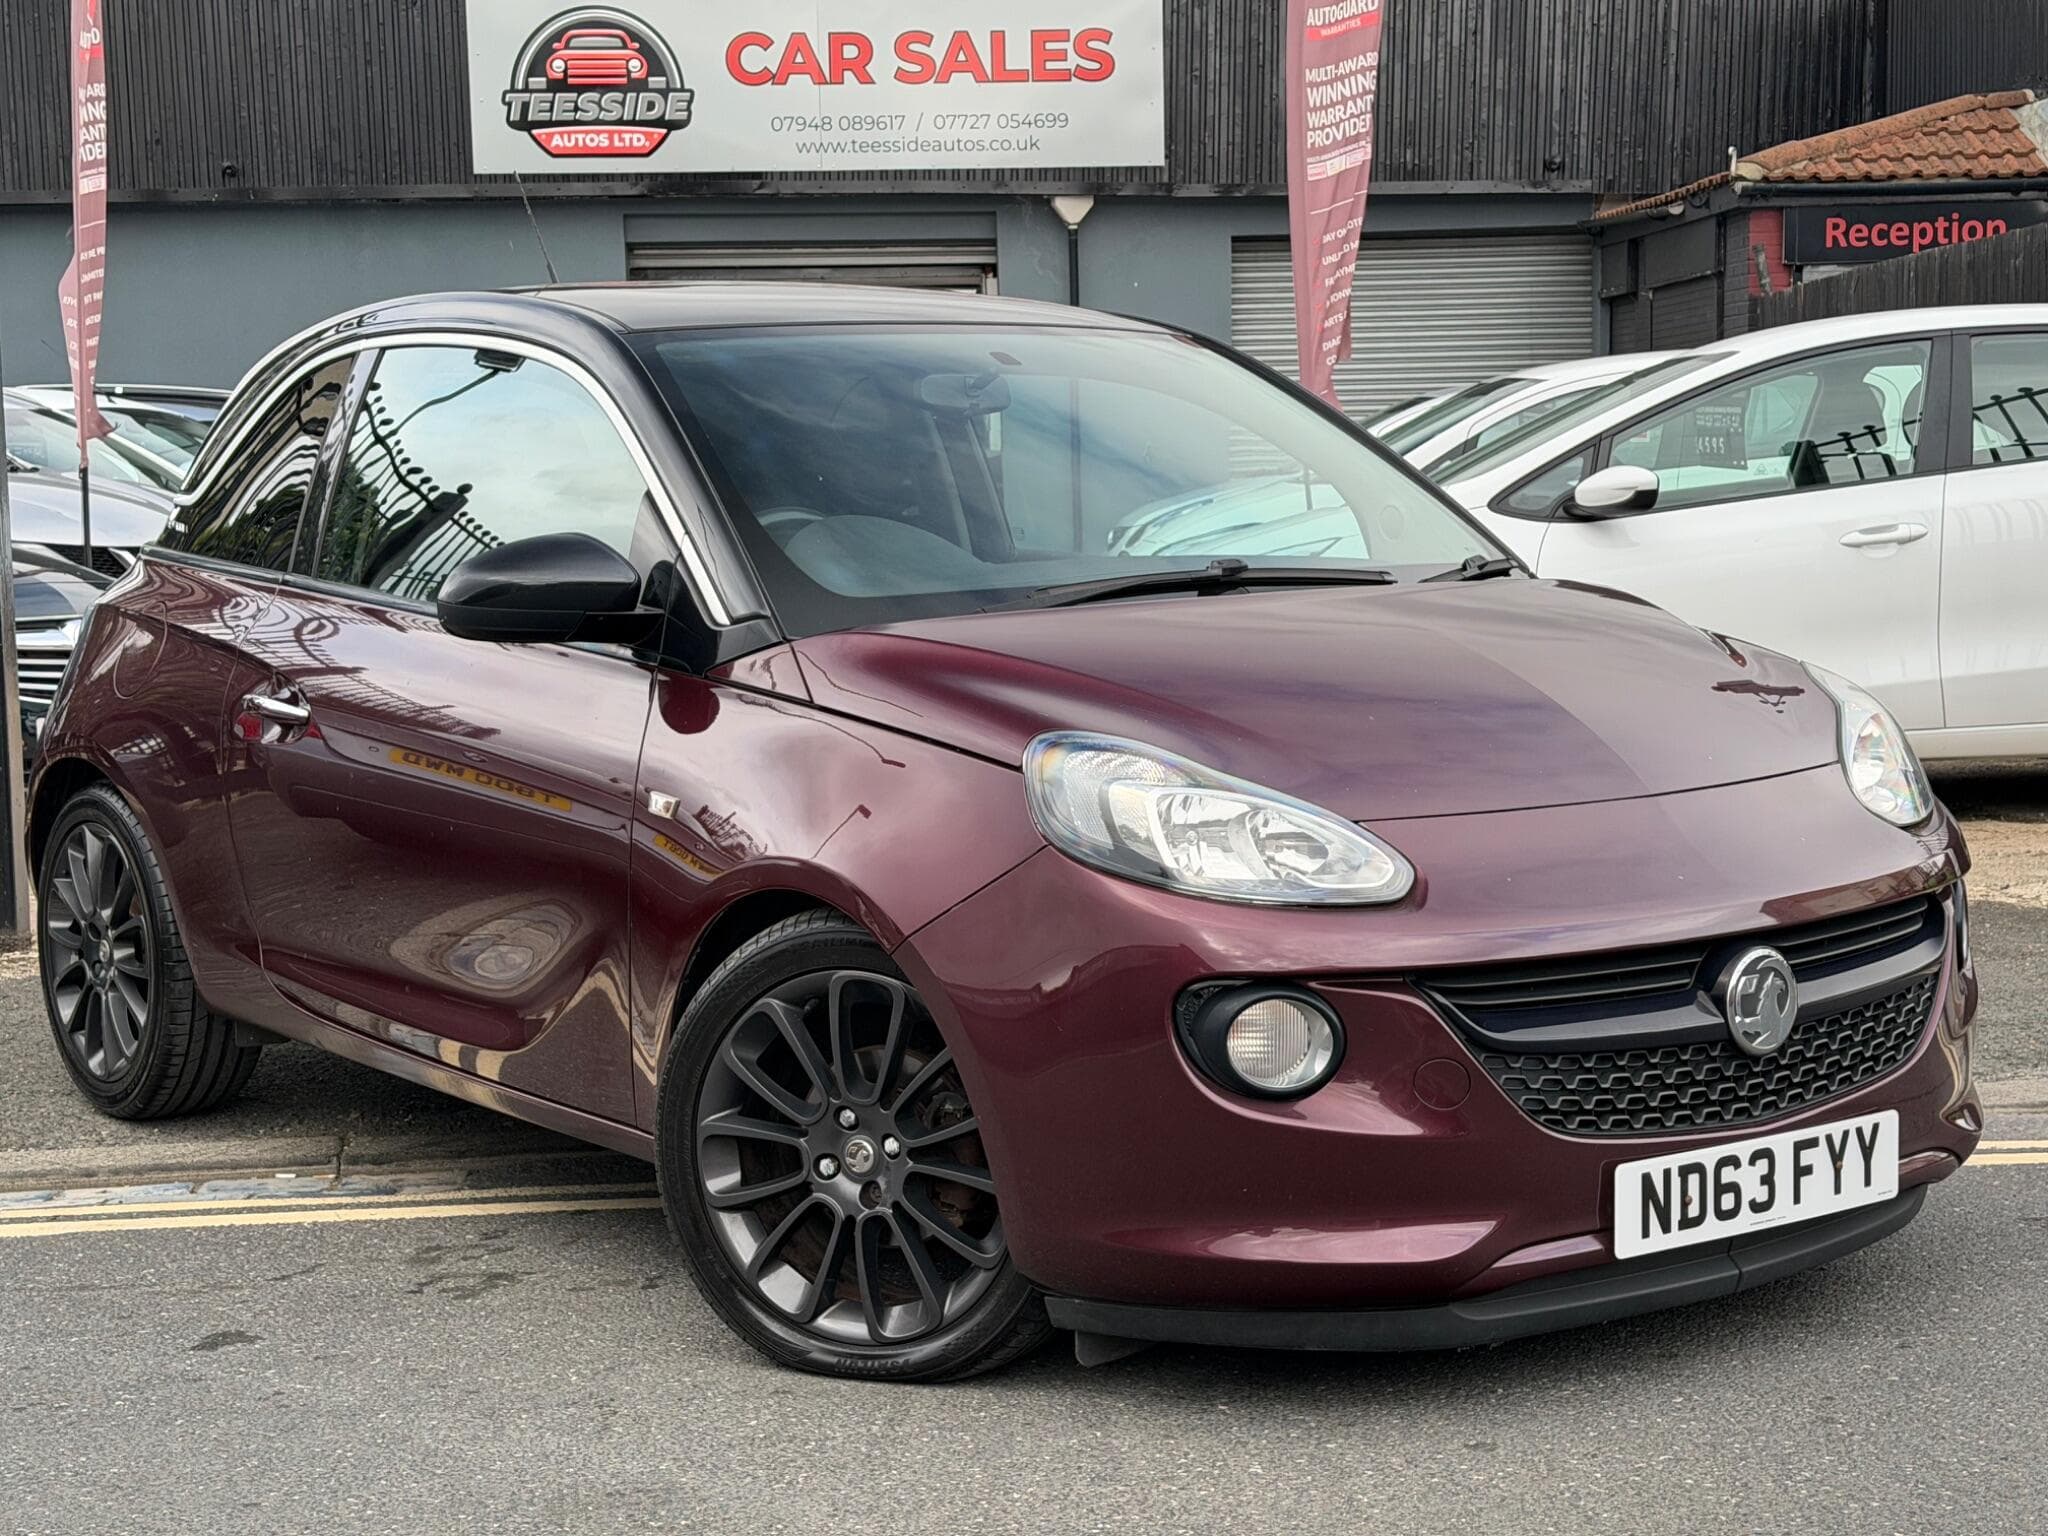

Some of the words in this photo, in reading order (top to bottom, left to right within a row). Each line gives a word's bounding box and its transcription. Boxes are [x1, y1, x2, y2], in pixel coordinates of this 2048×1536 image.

[1306, 0, 1378, 26] AUTOGUARD
[724, 31, 873, 86] CAR
[894, 28, 1116, 84] SALES
[1305, 52, 1379, 83] MULTI-AWARD
[1307, 71, 1377, 108] WINNING
[504, 91, 692, 122] TEESSIDE
[770, 115, 833, 132] 07948
[838, 114, 906, 132] 089617
[914, 112, 924, 132] /
[933, 113, 991, 130] 07727
[996, 112, 1069, 129] 054699
[1307, 94, 1374, 129] WARRANT
[551, 133, 610, 147] AUTOS
[795, 135, 1041, 154] www.teessideautos.co.uk
[1826, 213, 2007, 253] Reception
[1641, 1147, 1776, 1240] ND63
[1793, 1121, 1880, 1206] FYY
